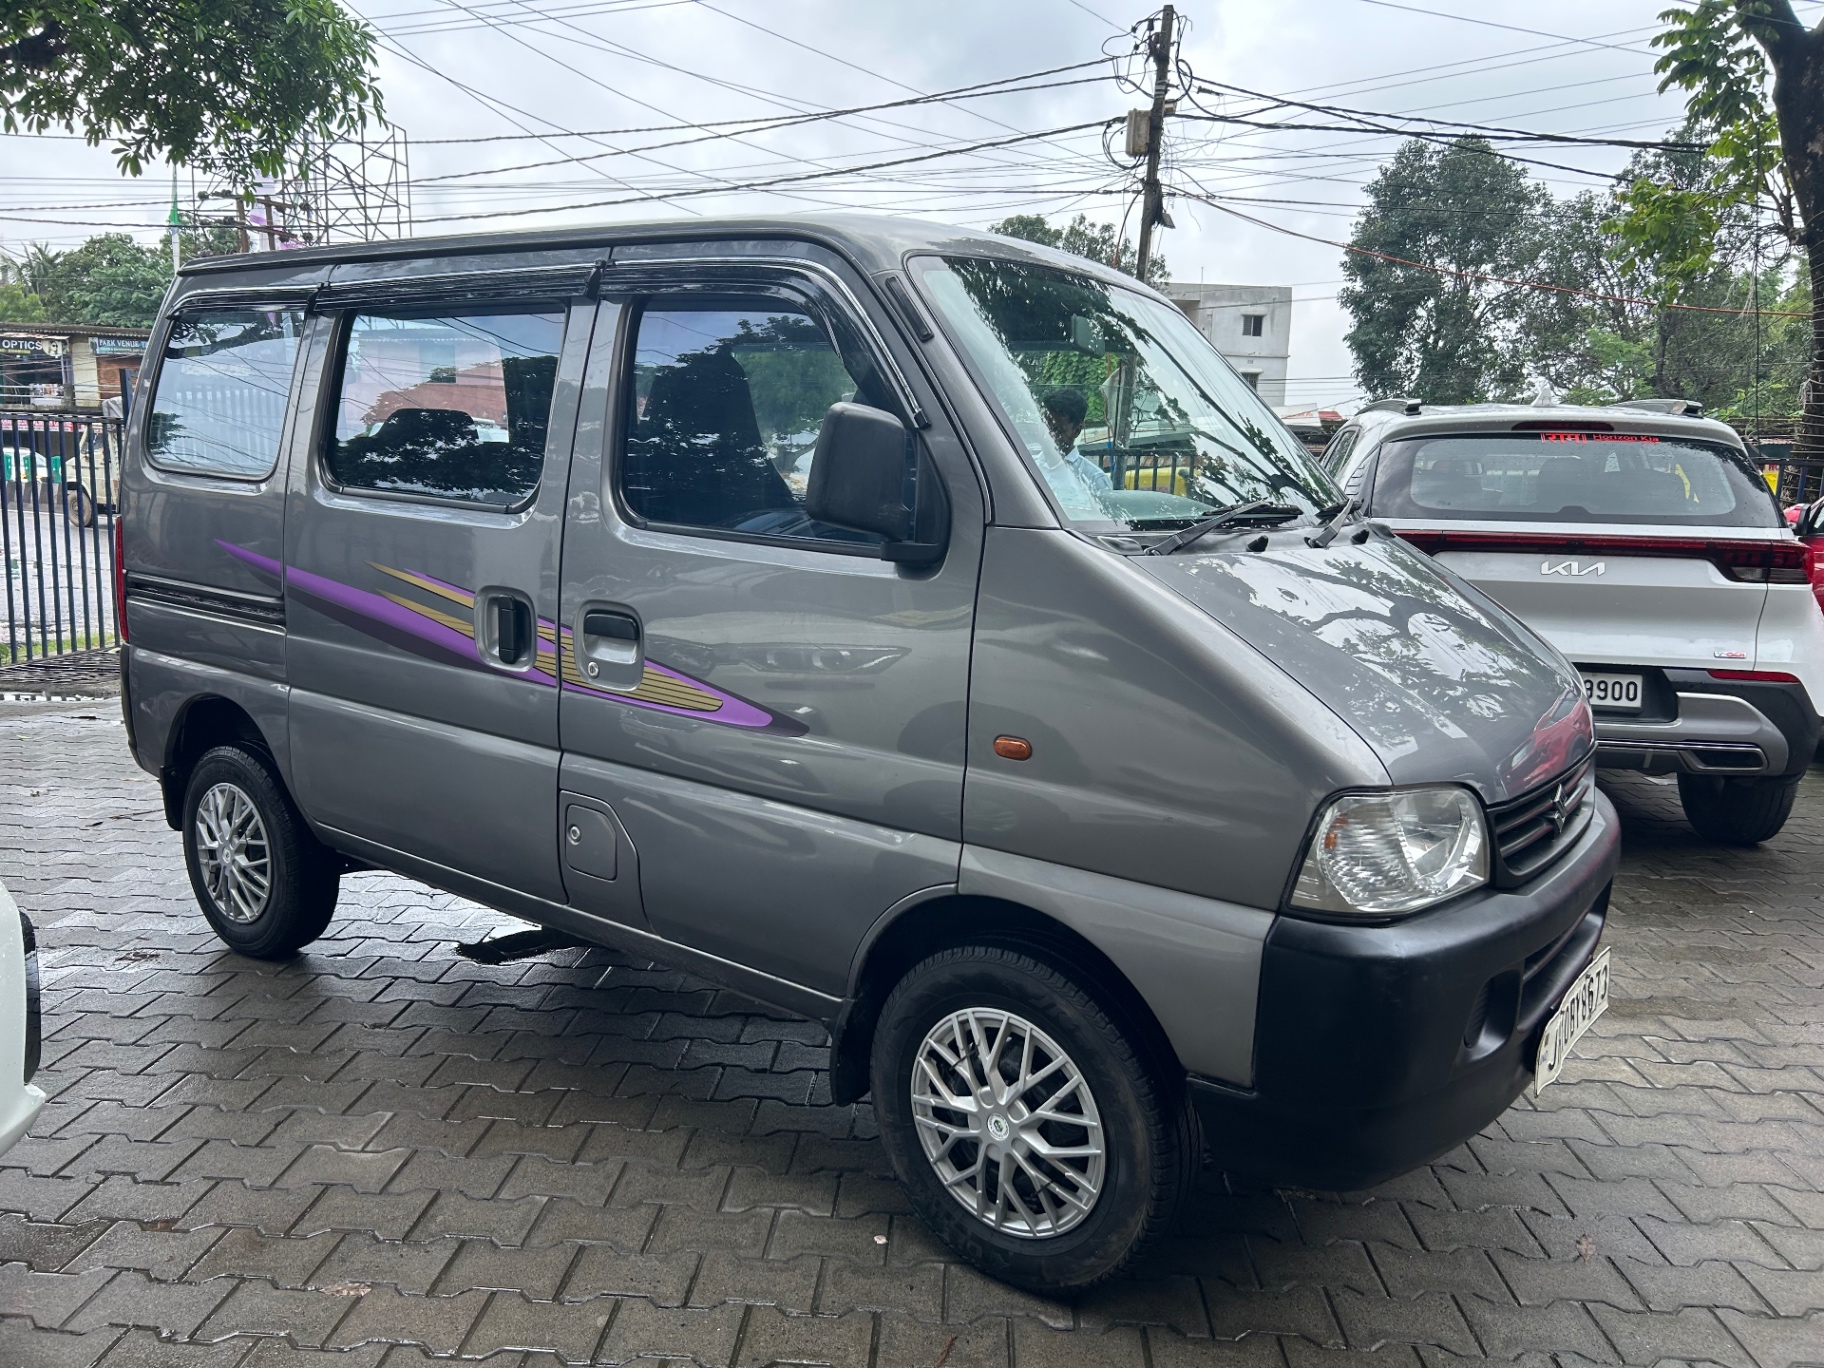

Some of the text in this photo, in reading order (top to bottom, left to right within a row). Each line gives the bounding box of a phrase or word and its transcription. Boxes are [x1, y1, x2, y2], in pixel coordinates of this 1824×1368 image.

[2, 340, 43, 350] OPTICS
[117, 340, 140, 348] VENUE
[1540, 560, 1606, 577] KIA
